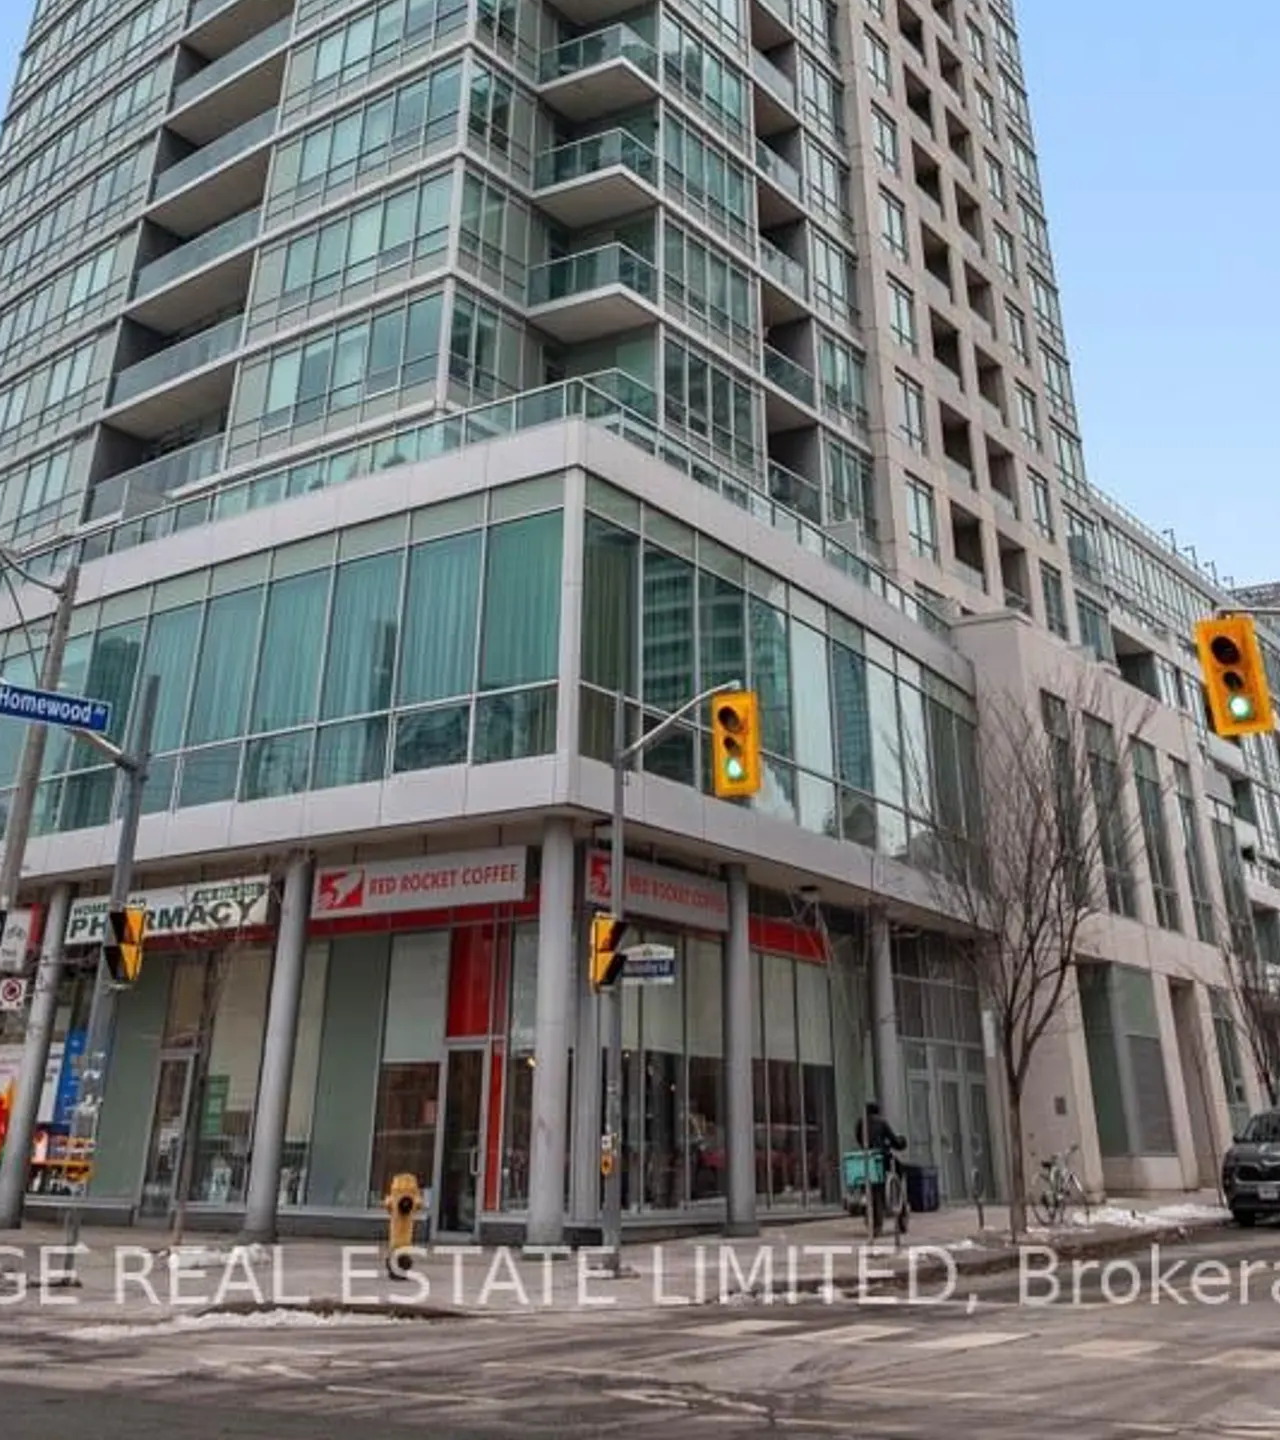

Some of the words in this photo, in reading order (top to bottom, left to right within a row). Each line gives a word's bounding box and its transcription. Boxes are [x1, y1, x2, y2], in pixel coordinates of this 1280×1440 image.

[370, 876, 397, 896] RED
[400, 869, 457, 894] ROCKET
[462, 863, 518, 886] COFFEE
[70, 895, 262, 938] PHRMACY
